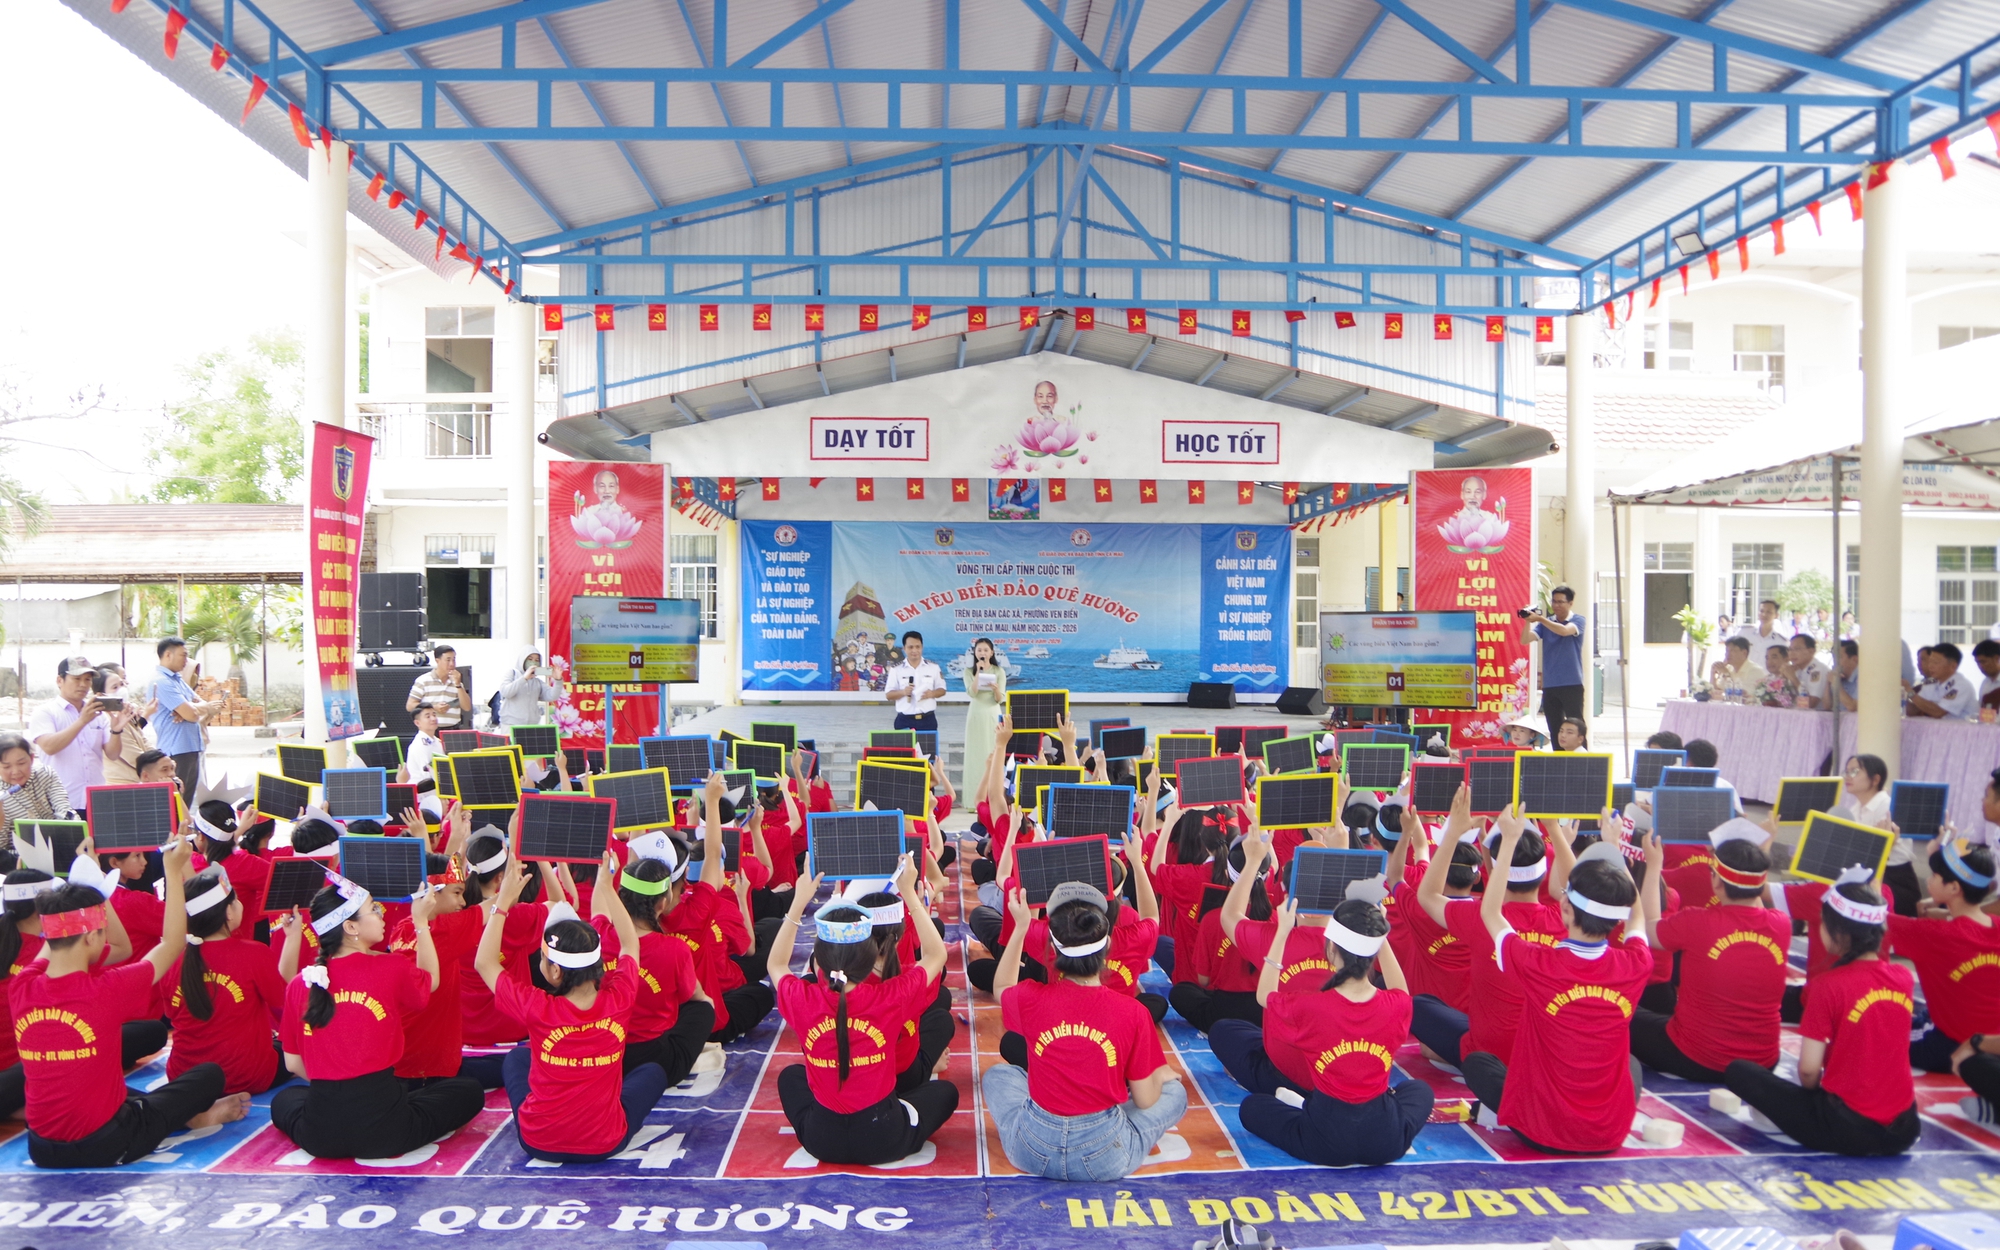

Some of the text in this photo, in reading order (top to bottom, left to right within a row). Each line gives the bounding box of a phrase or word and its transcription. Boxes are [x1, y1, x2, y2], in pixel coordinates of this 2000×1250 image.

[824, 422, 916, 452] DẠY TỐT
[1176, 428, 1266, 456] HỌC TỐT
[592, 553, 614, 566] VÌ
[780, 551, 810, 564] NGHIỆP
[1216, 555, 1277, 570] CẢNH SÁT BIỂN
[1466, 558, 1488, 571] VÌ
[766, 566, 806, 580] GIÁO DỤC
[956, 560, 1075, 578] VÒNG THI CẤP TỈNH CUỘC THI
[584, 572, 622, 588] LỢI
[1227, 574, 1265, 590] VIỆT NAM
[1458, 576, 1496, 593] LỢI
[761, 582, 810, 595] VÀ ĐÀO TẠO
[756, 598, 814, 610] LÀ SỰ NGHIỆP
[894, 604, 921, 623] EM
[920, 592, 954, 611] YÊU
[1004, 578, 1039, 596] ĐẢO
[1044, 586, 1079, 602] QUÊ
[1080, 593, 1139, 623] HƯƠNG
[1224, 594, 1267, 606] CHUNG TAY
[1457, 594, 1497, 606] ÍCH
[751, 610, 820, 625] CỦA TOÀN ĐẢNG,
[955, 608, 970, 618] TRÊN
[984, 608, 996, 618] BÀN
[998, 608, 1010, 618] CÁC
[1024, 608, 1048, 618] PHƯỜNG
[1050, 610, 1062, 618] VEN
[1064, 607, 1078, 618] BIỂN
[1219, 610, 1272, 626] VÌ SỰ NGHIỆP
[1475, 611, 1511, 625] ĂM
[762, 628, 784, 639] TOÀN
[956, 622, 968, 632] CỦA
[970, 622, 984, 632] TỈNH
[985, 622, 994, 632] CÀ
[1012, 622, 1026, 632] NĂM
[1028, 624, 1040, 634] HỌC
[1042, 624, 1056, 632] 2025
[1218, 626, 1272, 641] TRỒNG NGƯỜI
[1476, 629, 1505, 642] ĂM
[630, 656, 642, 664] 01
[1476, 646, 1495, 660] HÌ
[1476, 662, 1504, 678] ẢI
[1388, 676, 1402, 686] 01
[1038, 1030, 1054, 1046] YÊU
[1052, 1020, 1072, 1039] BIỂN
[1073, 1021, 1090, 1038] ĐẢO
[1089, 1029, 1106, 1044] QUÊ
[568, 1058, 578, 1067] 42
[1066, 1190, 1173, 1228] HẢI
[1189, 1190, 1366, 1226] ĐOÀN
[1379, 1186, 1590, 1221] 42/BTL
[1582, 1178, 1770, 1214] VÙNG
[1762, 1172, 1953, 1210] CẢNH
[0, 1186, 914, 1235] BIỂN, ĐẢO QUÊ HƯƠNG
